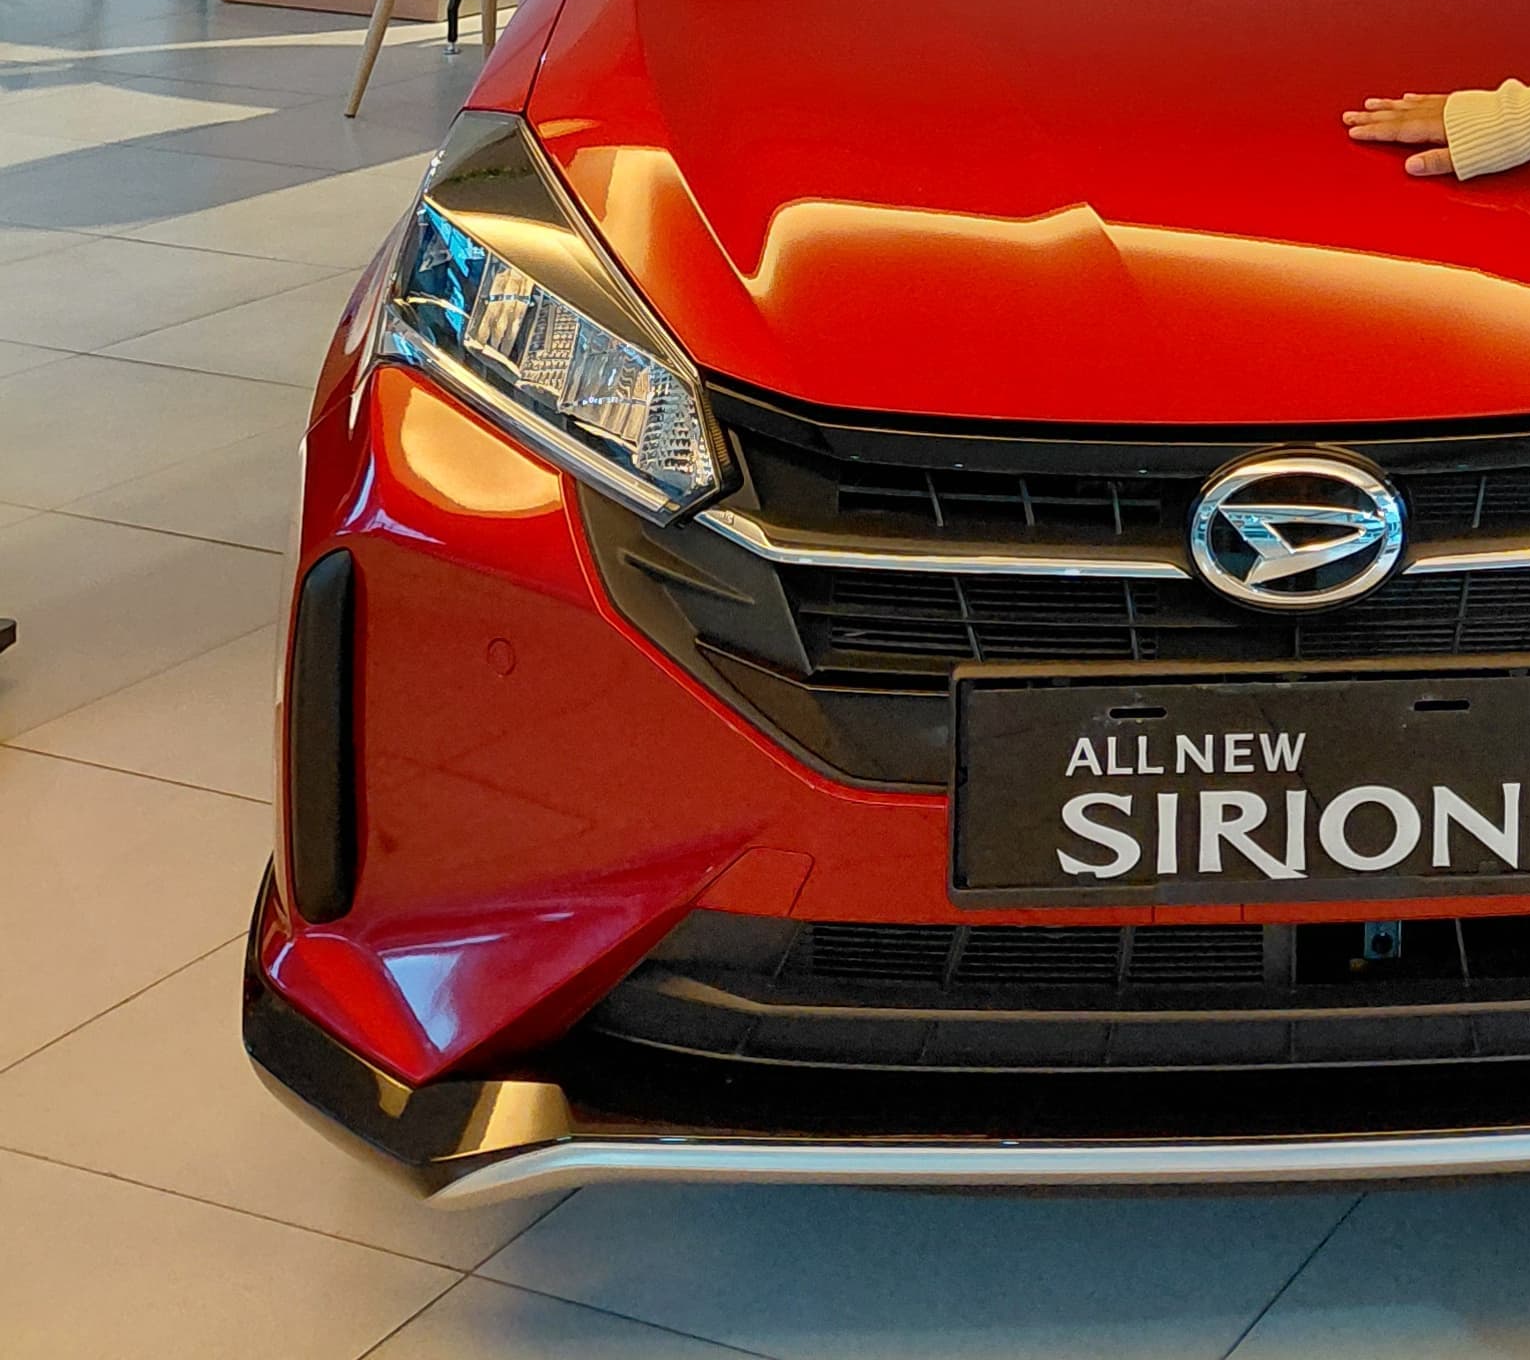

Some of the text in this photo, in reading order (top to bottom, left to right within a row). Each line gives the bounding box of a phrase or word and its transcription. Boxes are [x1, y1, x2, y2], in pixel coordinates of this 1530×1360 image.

[1065, 732, 1306, 778] ALL NEW
[1055, 782, 1521, 879] SIRION
